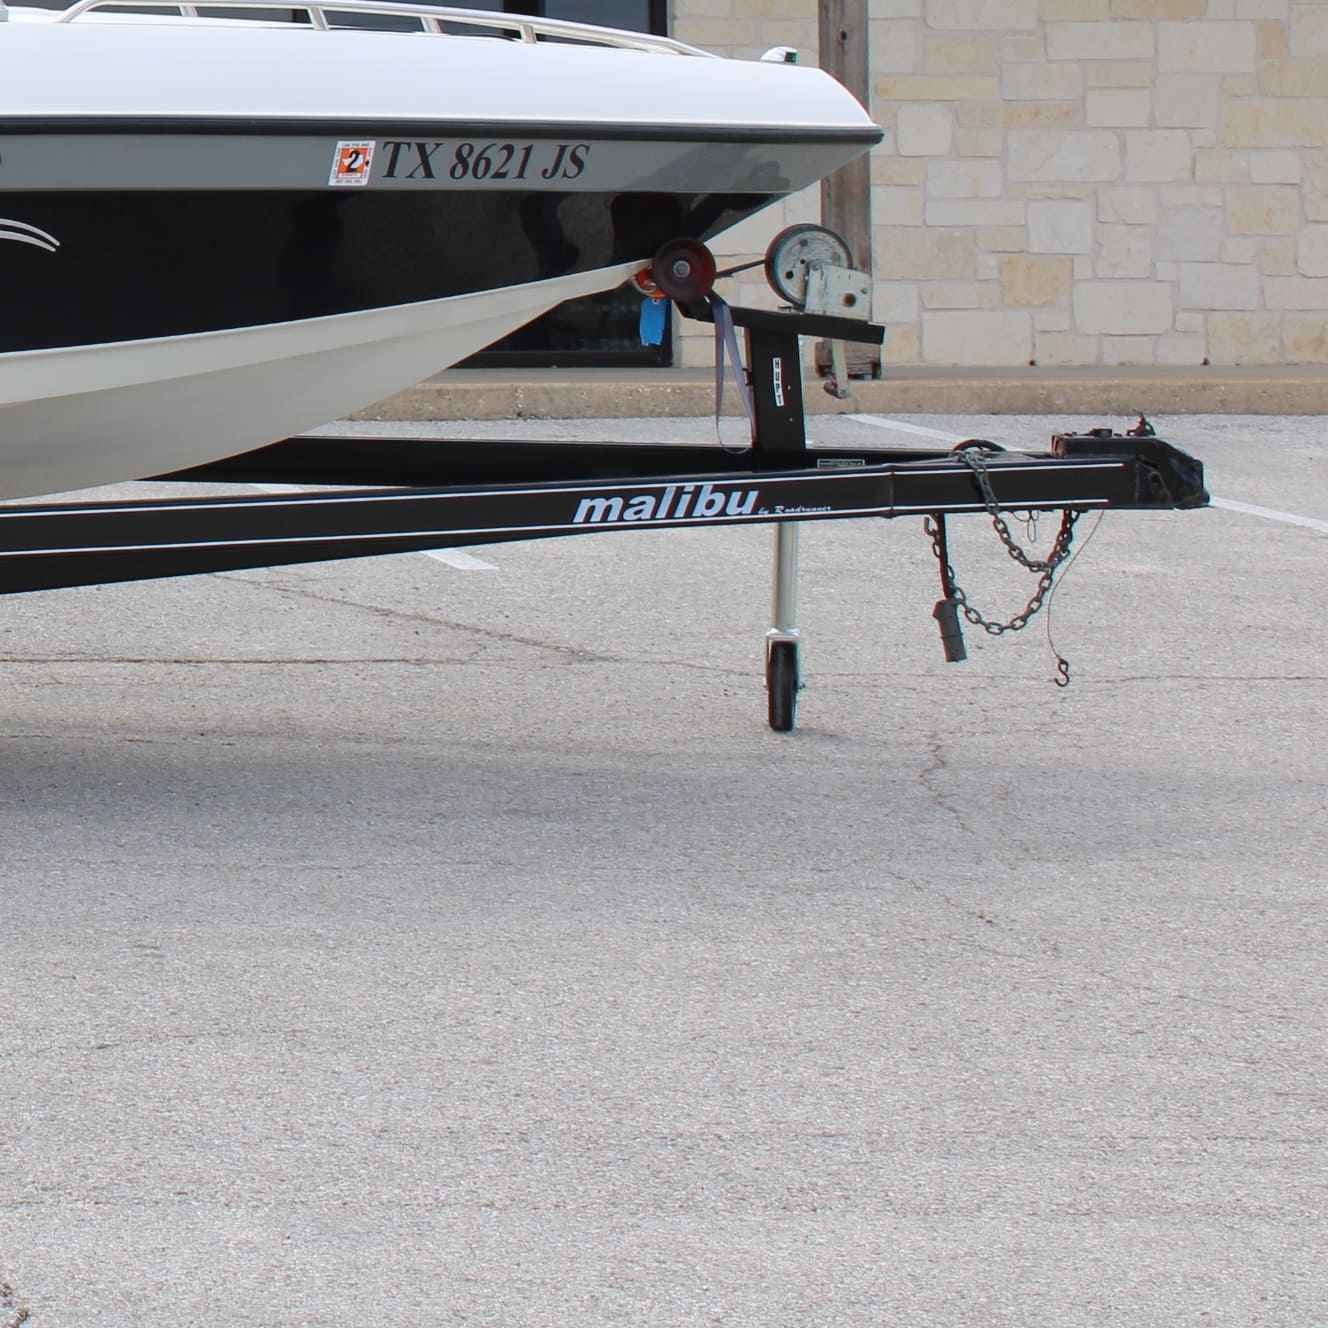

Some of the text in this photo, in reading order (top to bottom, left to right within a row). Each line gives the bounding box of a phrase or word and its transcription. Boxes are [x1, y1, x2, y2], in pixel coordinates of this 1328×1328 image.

[381, 141, 590, 180] TX 8621 JS
[573, 484, 760, 524] malibu
